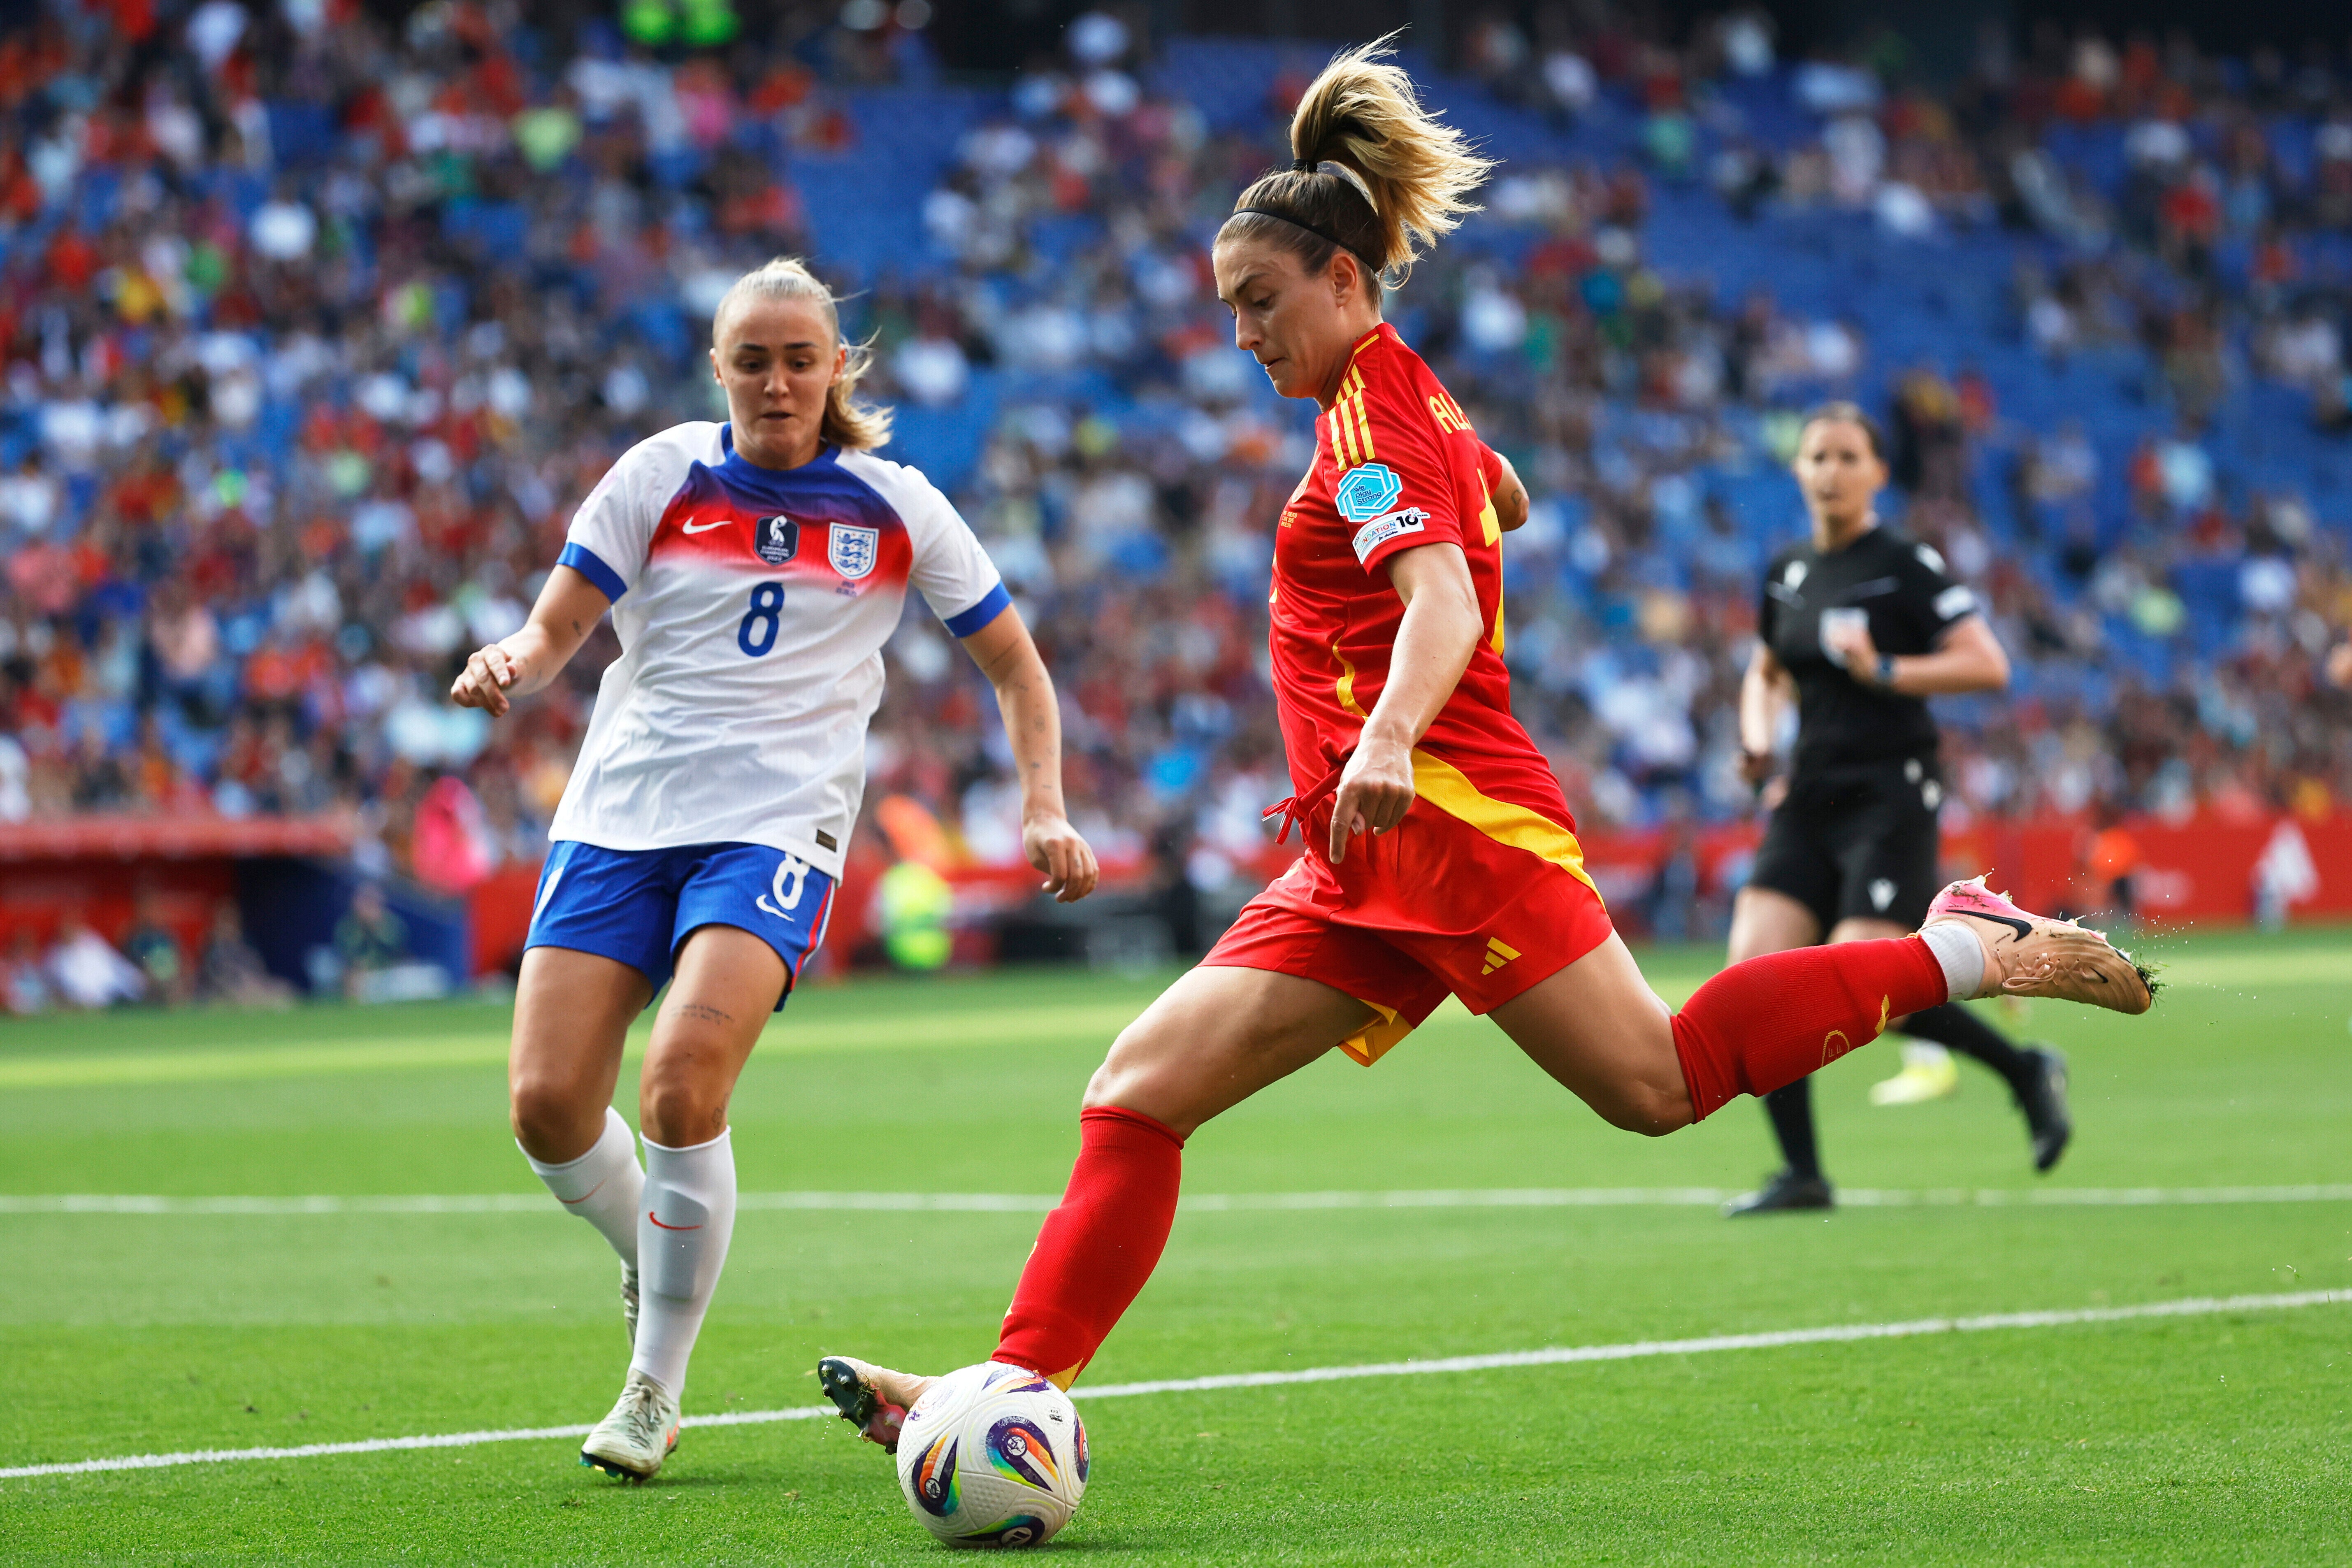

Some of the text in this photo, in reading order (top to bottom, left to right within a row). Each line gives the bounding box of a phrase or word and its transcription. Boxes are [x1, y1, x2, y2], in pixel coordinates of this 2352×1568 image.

[1429, 393, 1475, 434] ALE
[1357, 492, 1382, 504] Strong
[1356, 522, 1396, 554] FOUNDATION
[1396, 515, 1419, 527] 10
[738, 581, 785, 657] 8
[773, 852, 811, 911] 8
